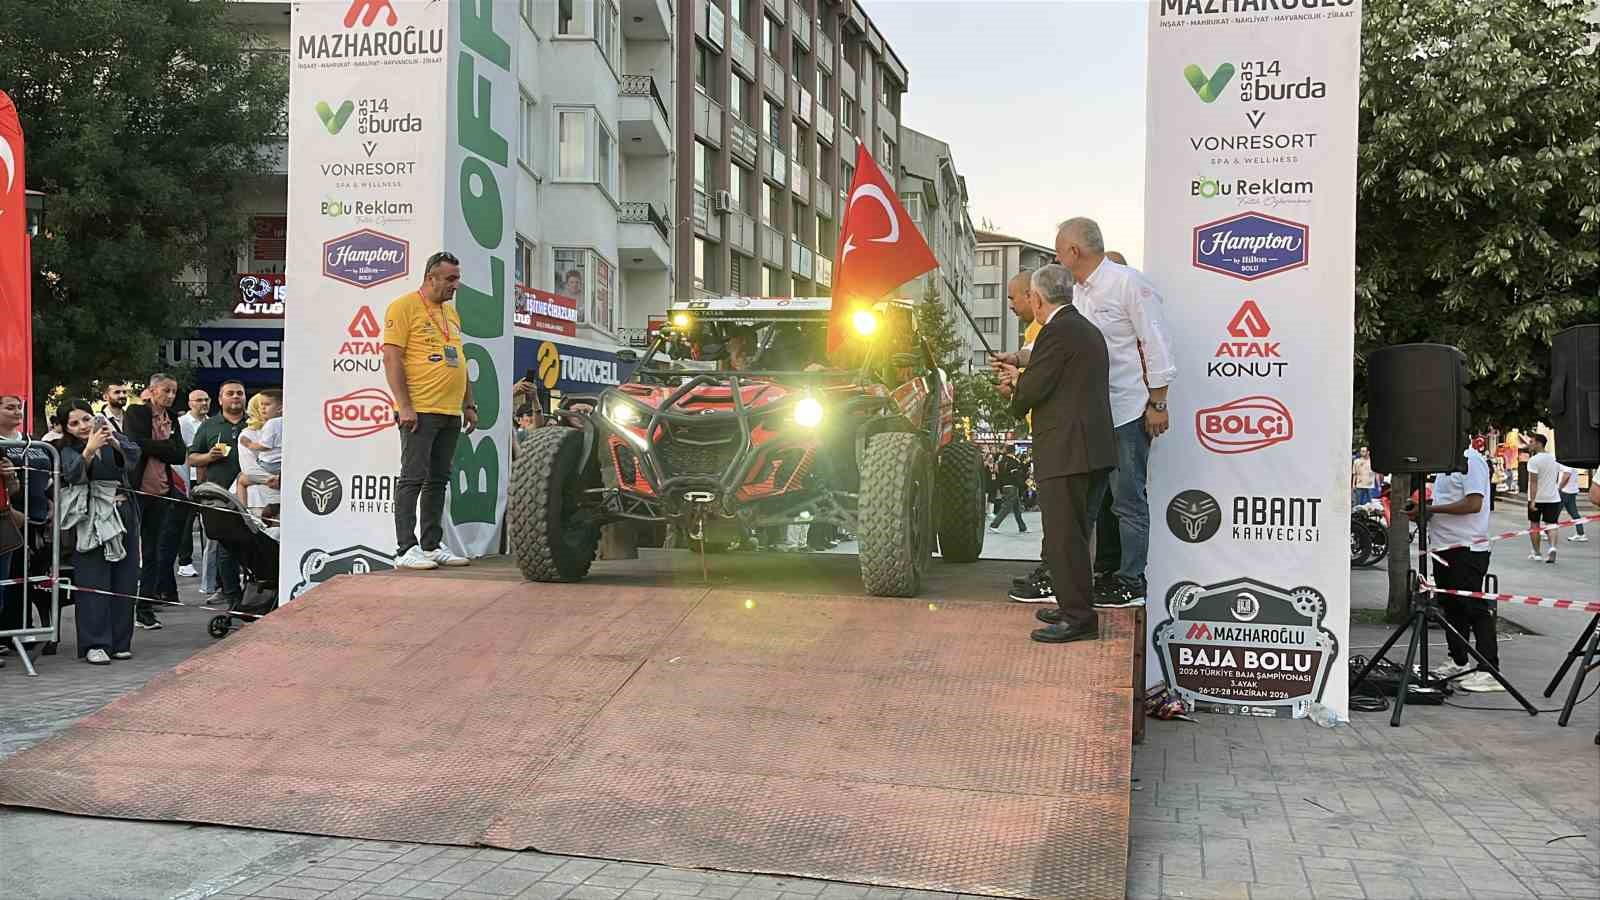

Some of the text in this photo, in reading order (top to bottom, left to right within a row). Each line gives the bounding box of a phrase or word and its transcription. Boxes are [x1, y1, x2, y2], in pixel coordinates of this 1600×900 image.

[298, 26, 443, 59] MAZHAROĞLU
[1255, 60, 1281, 77] 14
[1240, 61, 1252, 101] esas
[1254, 77, 1326, 101] burda
[370, 99, 389, 113] 14
[369, 113, 422, 134] burda
[1190, 133, 1317, 151] VONRESORT
[320, 162, 416, 177] VONRESORT
[1237, 178, 1313, 195] Reklam
[355, 200, 413, 215] Reklam
[1200, 230, 1302, 255] Hampton
[328, 245, 404, 267] Hampton
[164, 340, 285, 369] URKCE
[1215, 342, 1280, 357] ATAK
[333, 358, 384, 372] KONU
[560, 355, 620, 385] TURKCELL
[1208, 362, 1288, 377] KONUT
[352, 475, 400, 500] ABA
[351, 501, 396, 513] KAHVEC
[1233, 496, 1321, 527] ABANT
[1214, 626, 1305, 645] MAZHAROĞLU
[1179, 647, 1311, 672] BAJA BOLU
[1179, 668, 1199, 676] 2026
[1200, 667, 1233, 677] TÜRKİYE
[1235, 671, 1254, 679] BAJA
[1233, 687, 1268, 697] HAZİRAN
